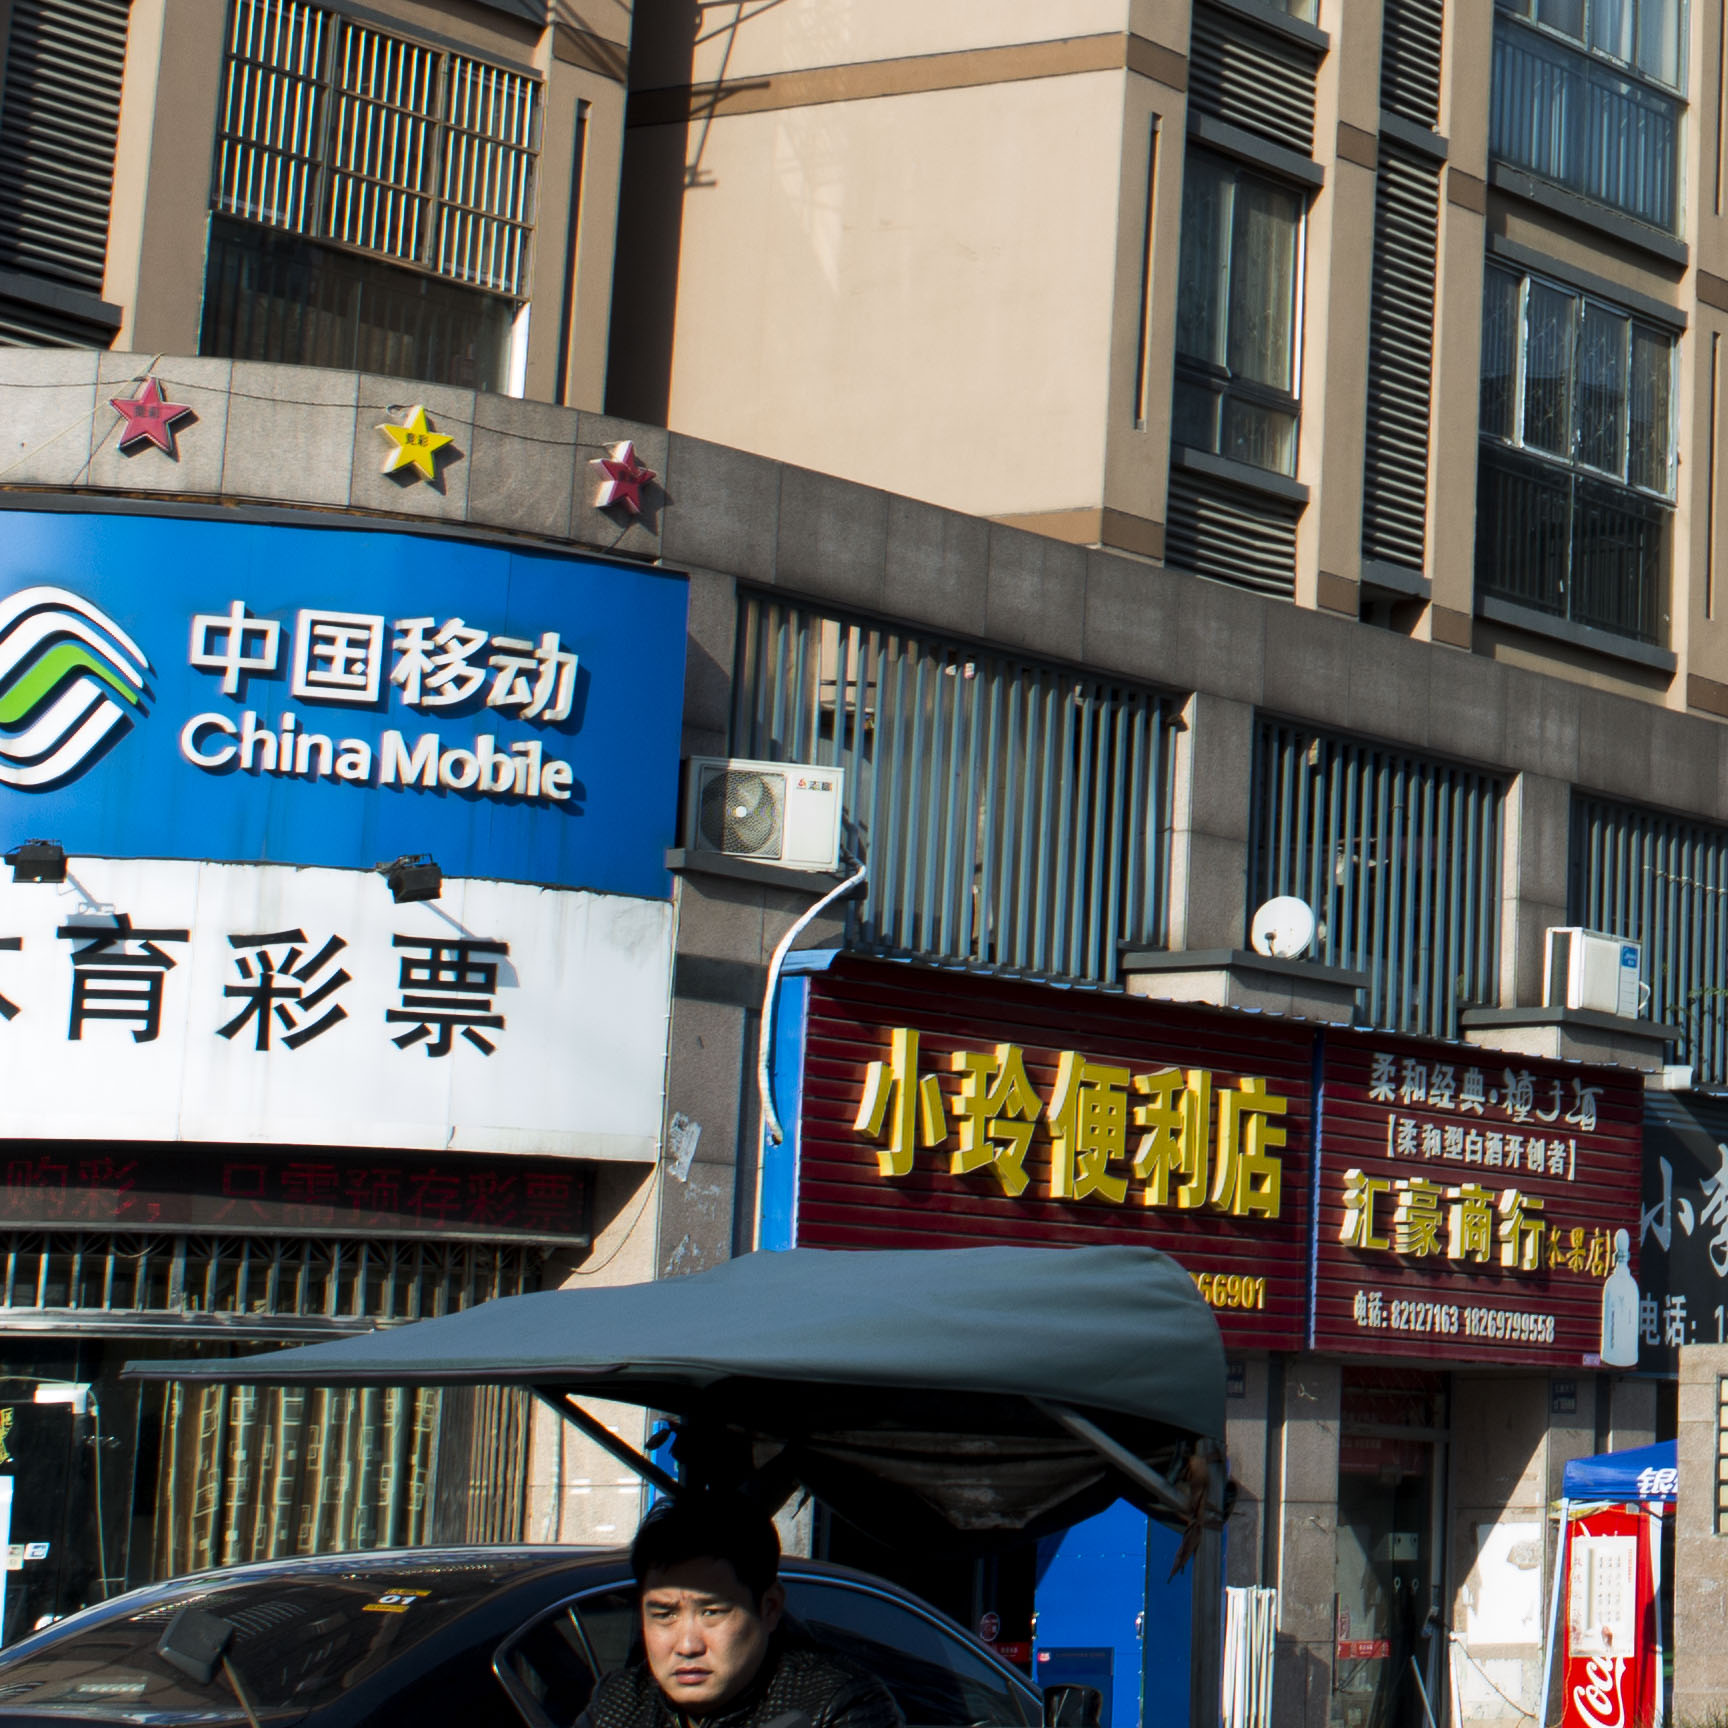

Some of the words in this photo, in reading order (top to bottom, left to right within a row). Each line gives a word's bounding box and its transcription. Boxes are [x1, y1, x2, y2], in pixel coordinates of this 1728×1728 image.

[188, 599, 581, 722] 中国移动
[180, 709, 372, 783] China
[379, 729, 575, 802] Mobile
[853, 1027, 1289, 1220] 小玲便利店
[1339, 1168, 1546, 1271] 汇豪商行
[1189, 1271, 1267, 1310] 66901
[1391, 1299, 1460, 1337] 82127163
[1636, 1466, 1679, 1495] 银
